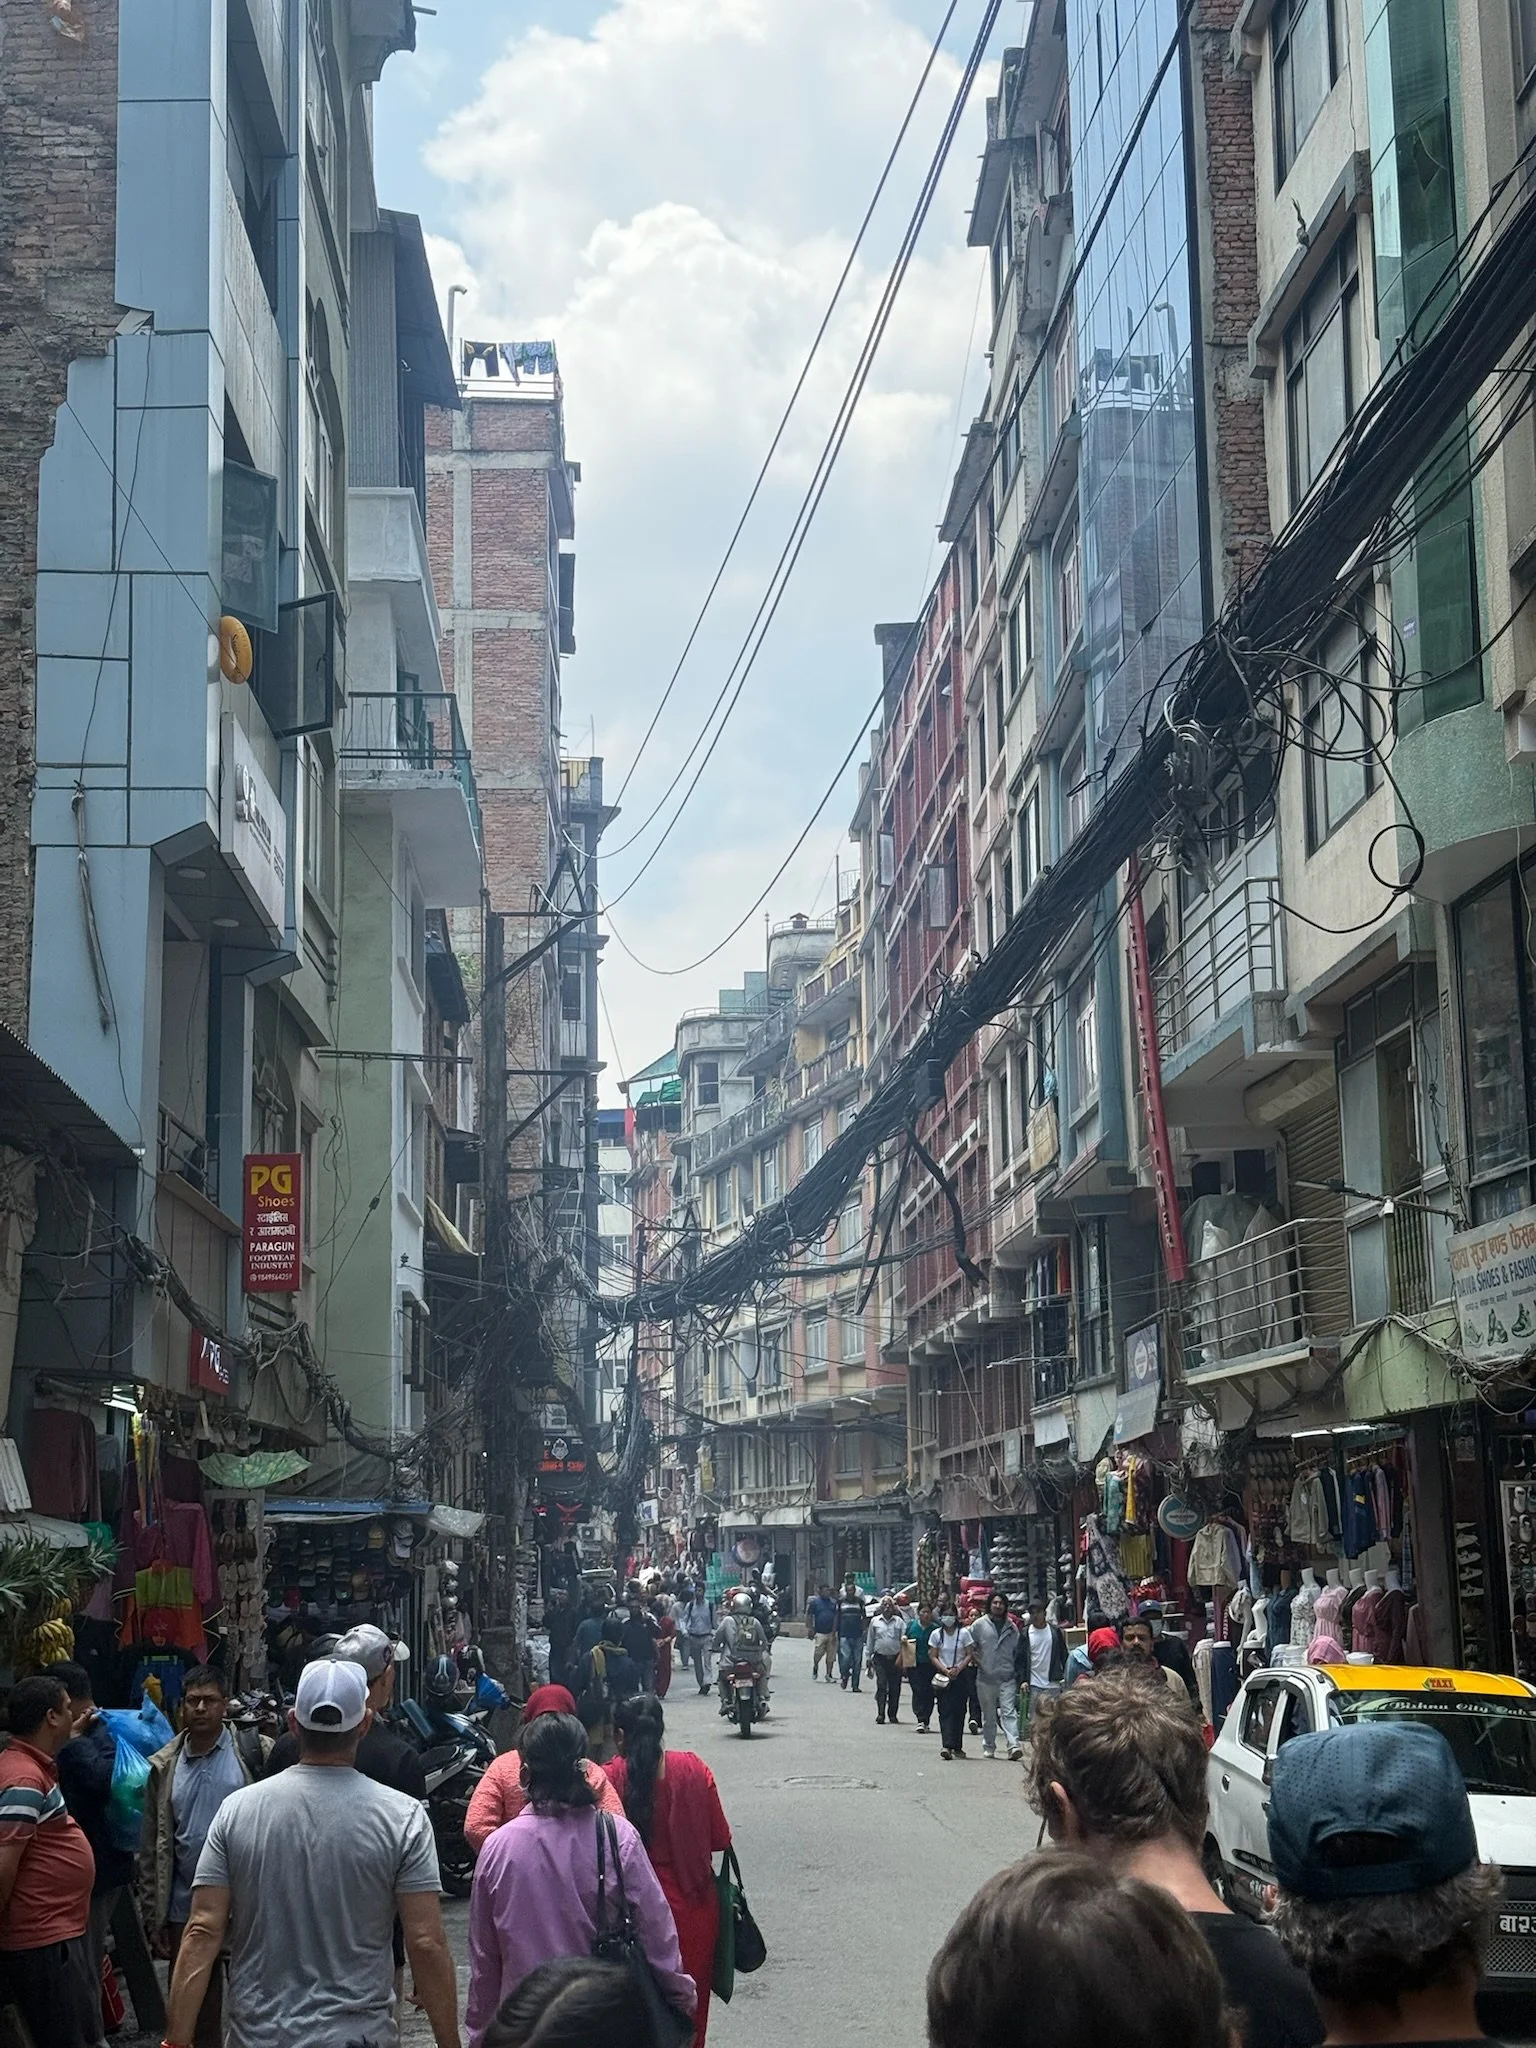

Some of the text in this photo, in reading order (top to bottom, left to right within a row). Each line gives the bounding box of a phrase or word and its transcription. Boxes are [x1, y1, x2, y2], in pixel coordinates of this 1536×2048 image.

[250, 1164, 292, 1195] PG
[257, 1195, 295, 1208] Shoes
[249, 1242, 295, 1252] PARAGUN
[249, 1254, 296, 1262] FOOTWEAR
[250, 1262, 294, 1270] INDUSTRY
[1477, 1267, 1501, 1292] SHOES
[1501, 1265, 1510, 1285] &
[1430, 1678, 1454, 1688] TAXI
[1390, 1701, 1448, 1711] Bishnu
[1456, 1702, 1489, 1714] City
